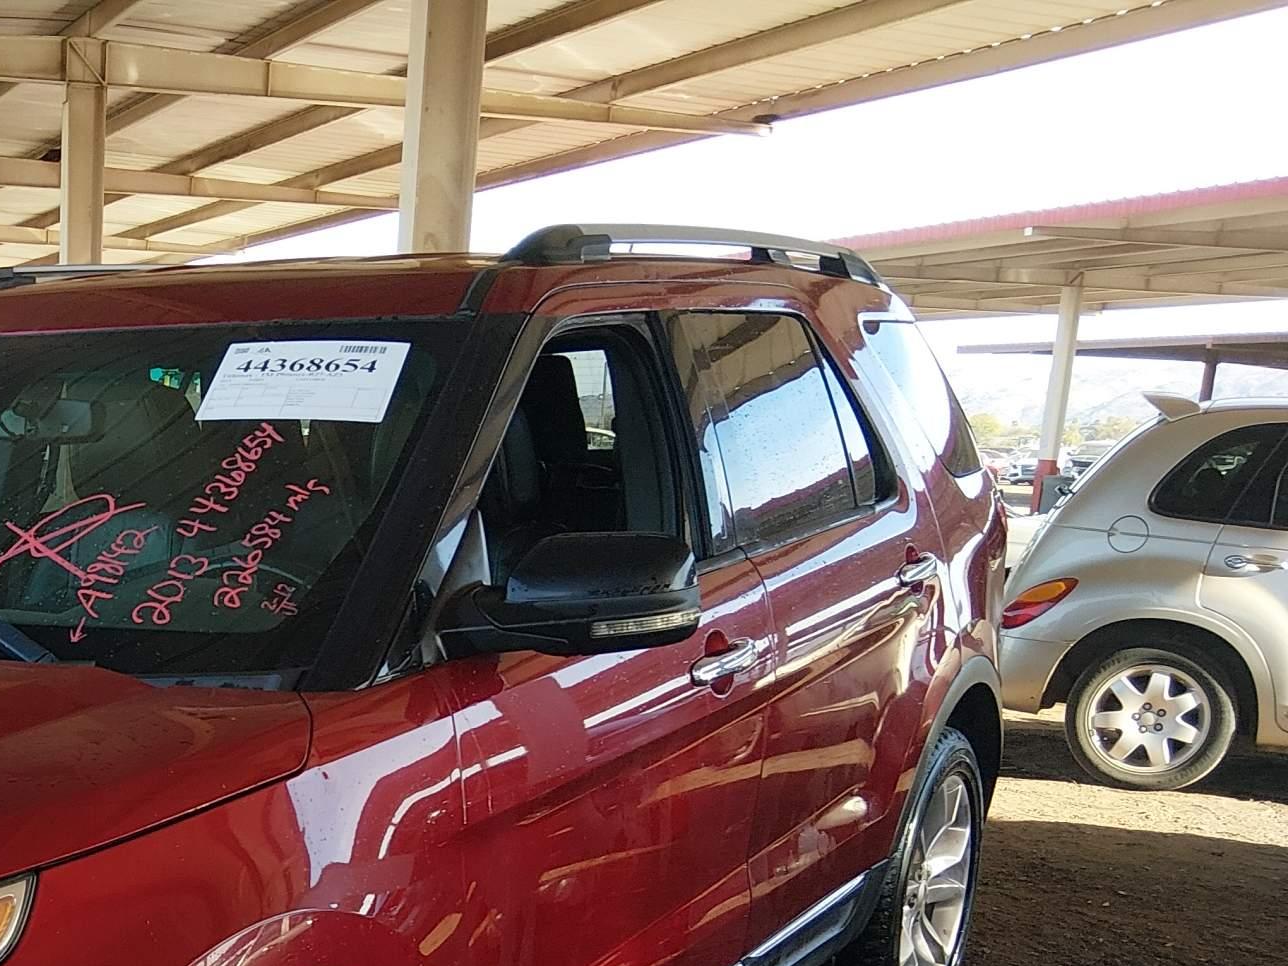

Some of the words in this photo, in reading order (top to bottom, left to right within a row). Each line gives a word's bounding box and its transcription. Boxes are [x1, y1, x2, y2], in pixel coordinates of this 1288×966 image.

[236, 357, 378, 373] 44368654
[132, 554, 209, 625] 2013
[176, 422, 286, 537] 44368654
[214, 511, 293, 608] 226584
